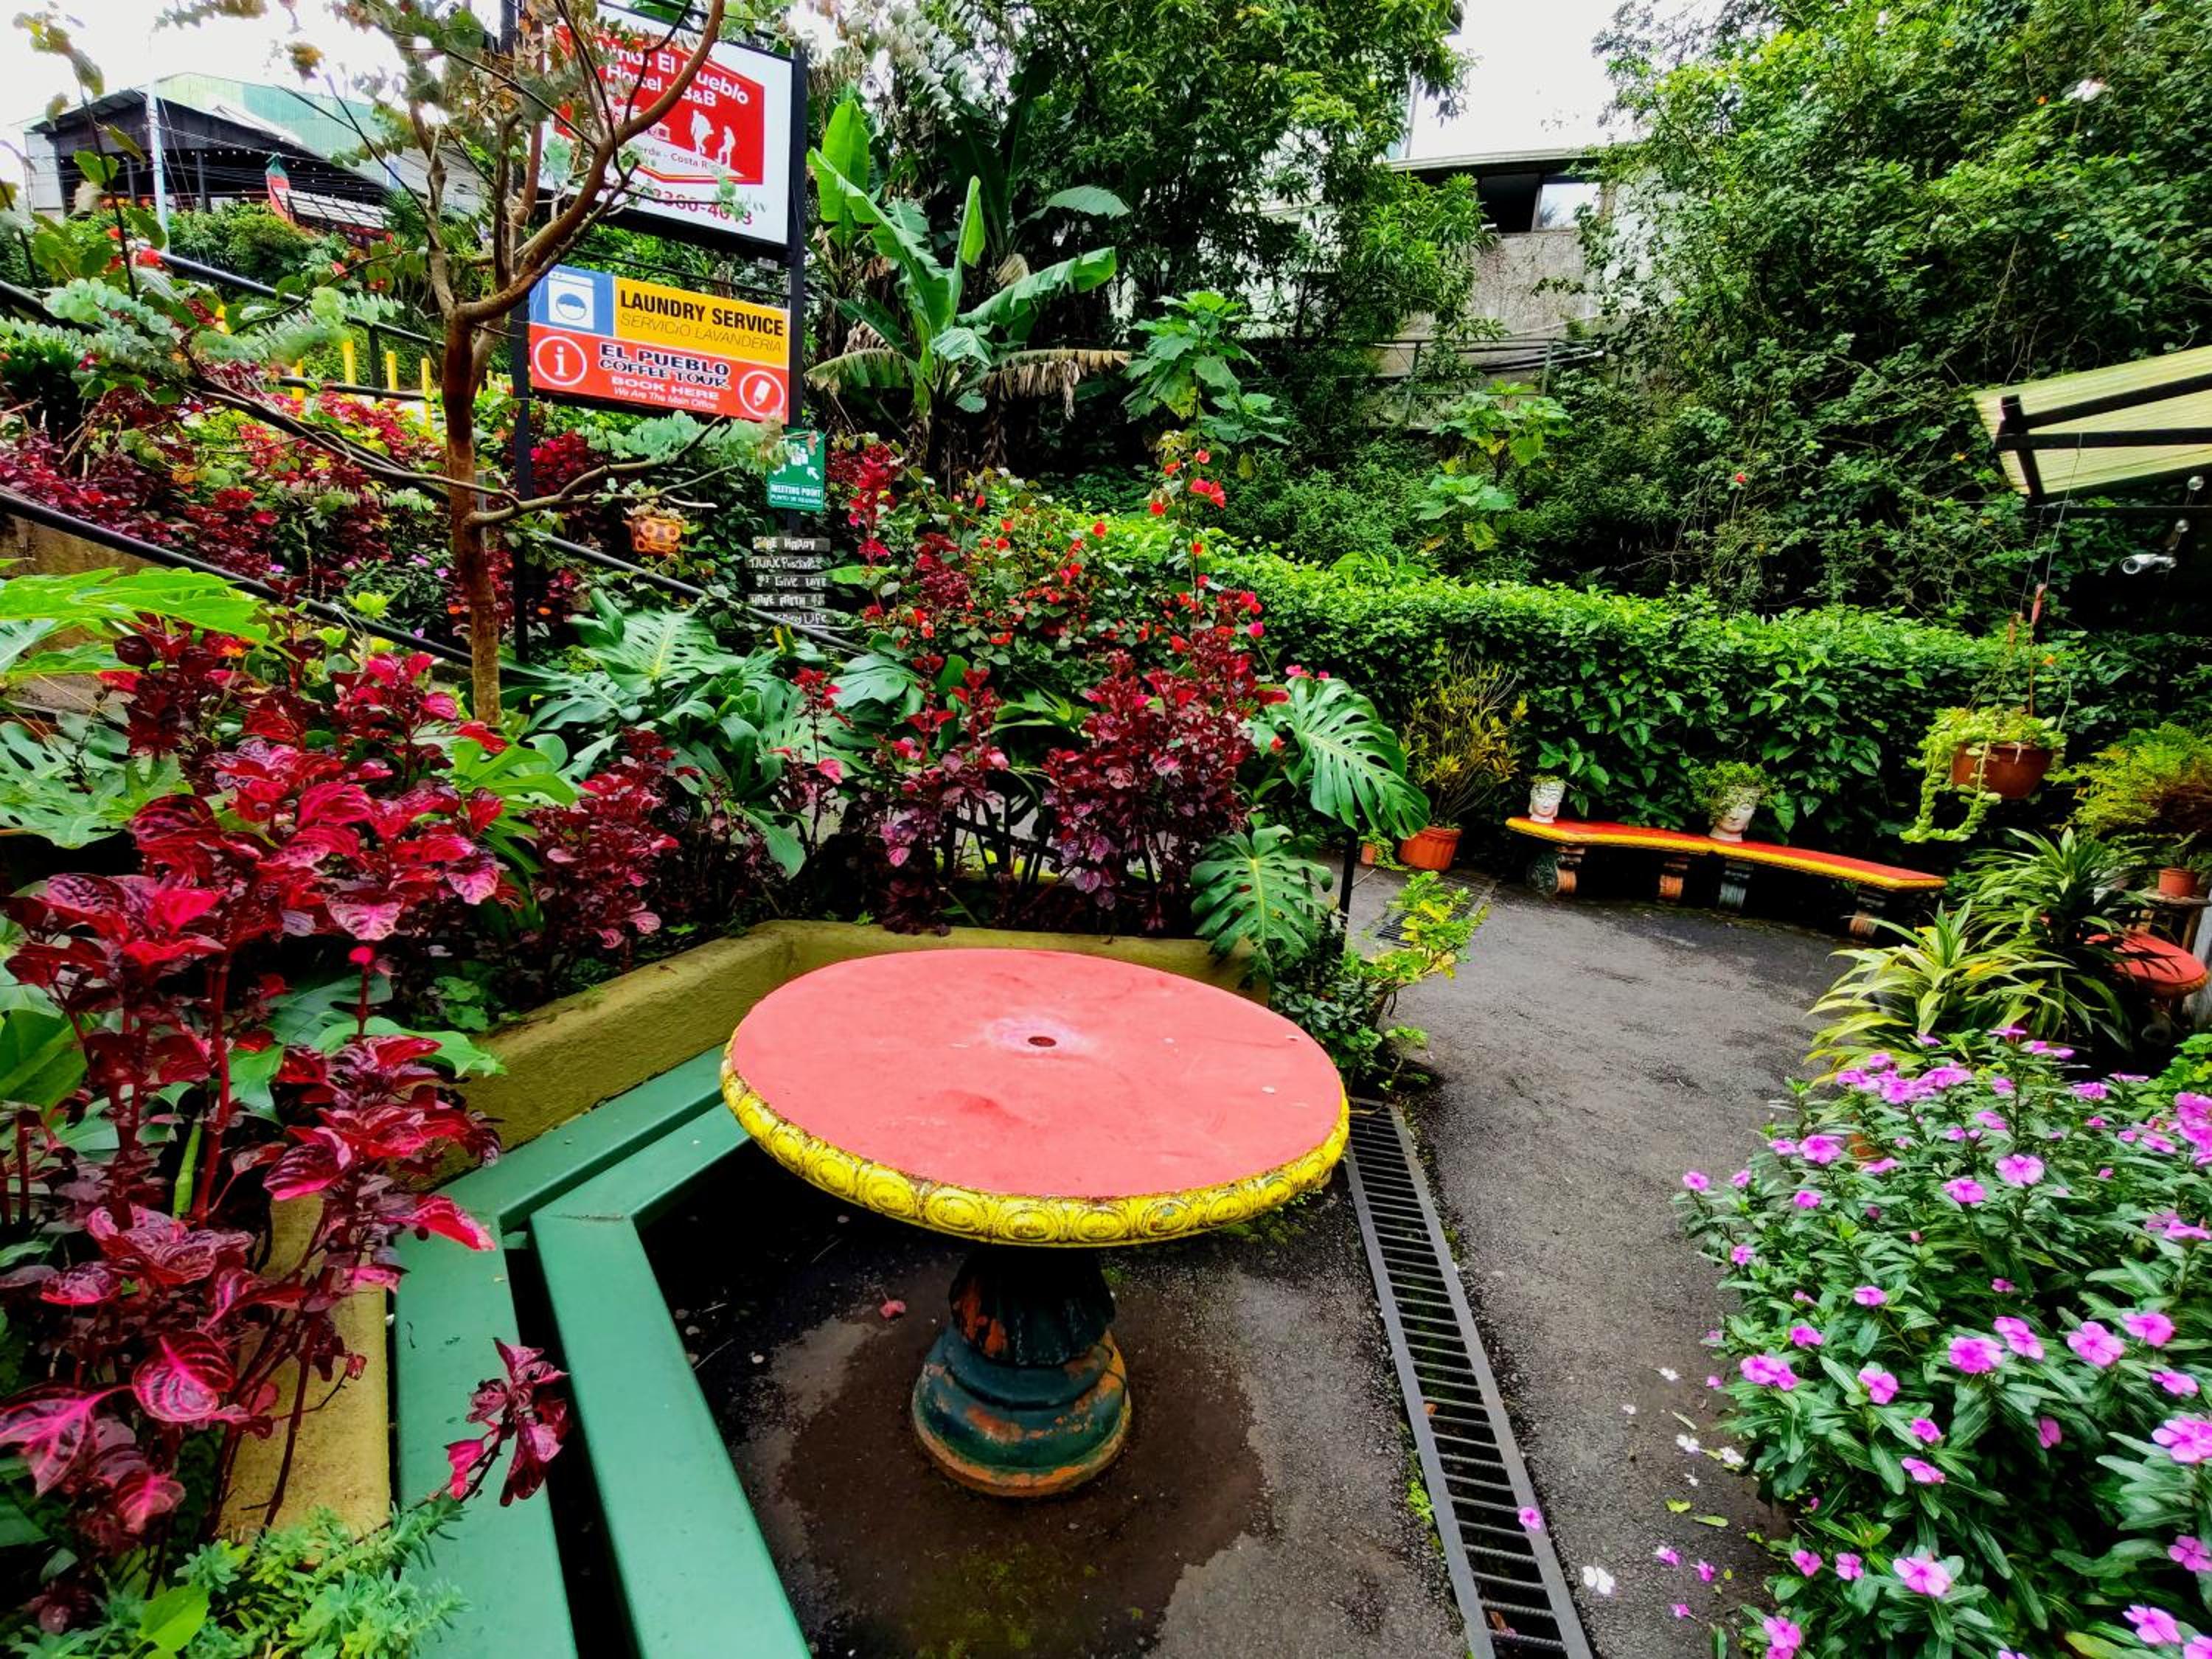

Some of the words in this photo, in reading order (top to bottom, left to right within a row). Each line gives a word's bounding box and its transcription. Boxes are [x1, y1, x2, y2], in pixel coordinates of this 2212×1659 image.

[657, 52, 676, 74] El
[670, 152, 698, 167] Costa
[620, 290, 706, 325] LAUNDRY
[712, 307, 785, 336] SERVICE
[599, 342, 630, 361] EL
[638, 349, 731, 377] PUEBLO
[599, 358, 670, 380] COFFEE
[611, 376, 666, 392] BOOK
[671, 386, 720, 401] HERE
[614, 386, 629, 397] We
